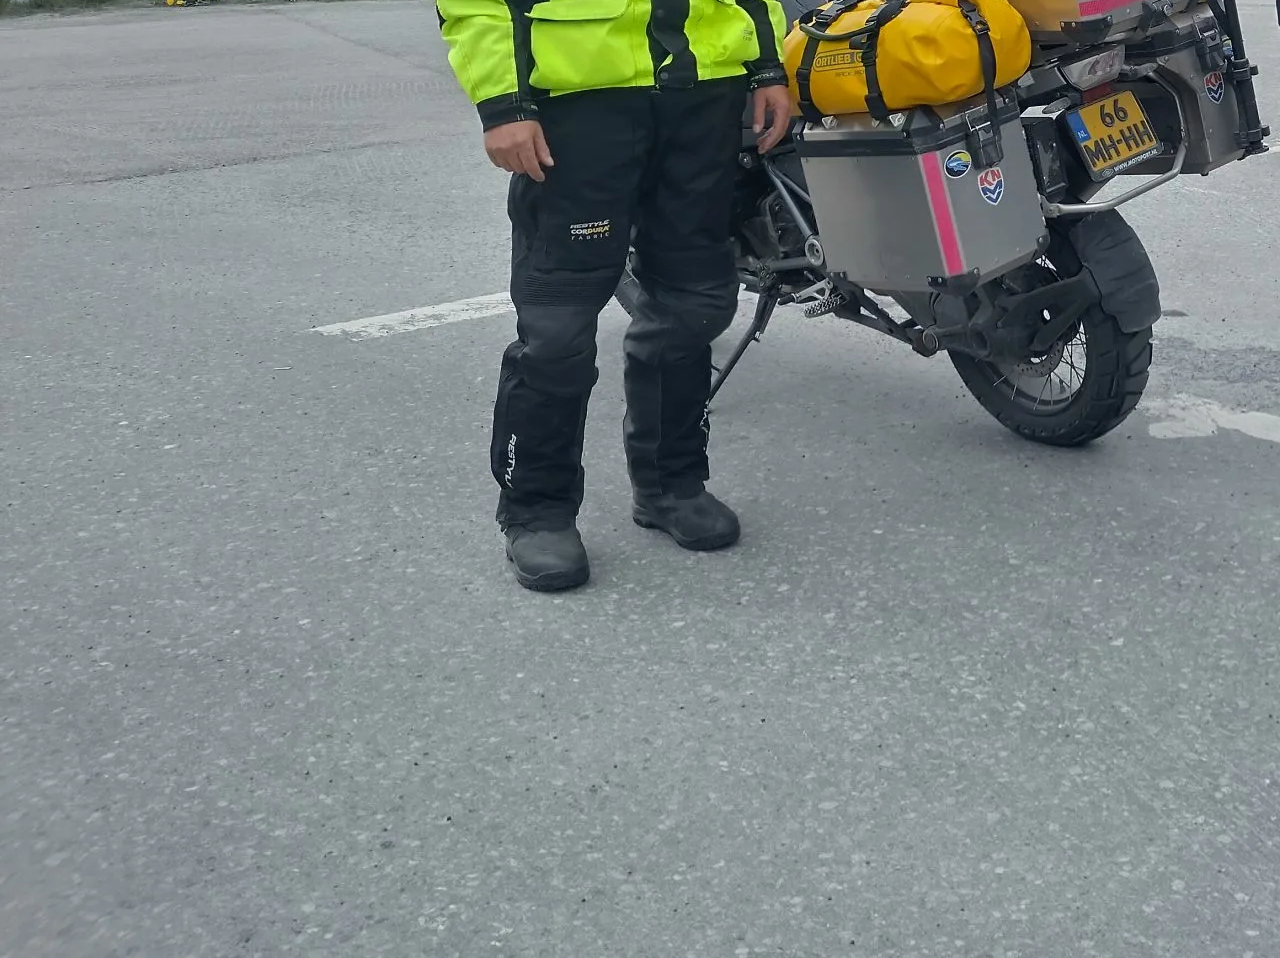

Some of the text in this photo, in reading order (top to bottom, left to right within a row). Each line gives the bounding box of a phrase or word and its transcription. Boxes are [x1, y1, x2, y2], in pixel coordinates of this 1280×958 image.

[815, 52, 851, 67] ORTLIEB
[1099, 98, 1129, 128] 66
[1077, 129, 1088, 139] NL
[1083, 120, 1154, 168] MH-HH
